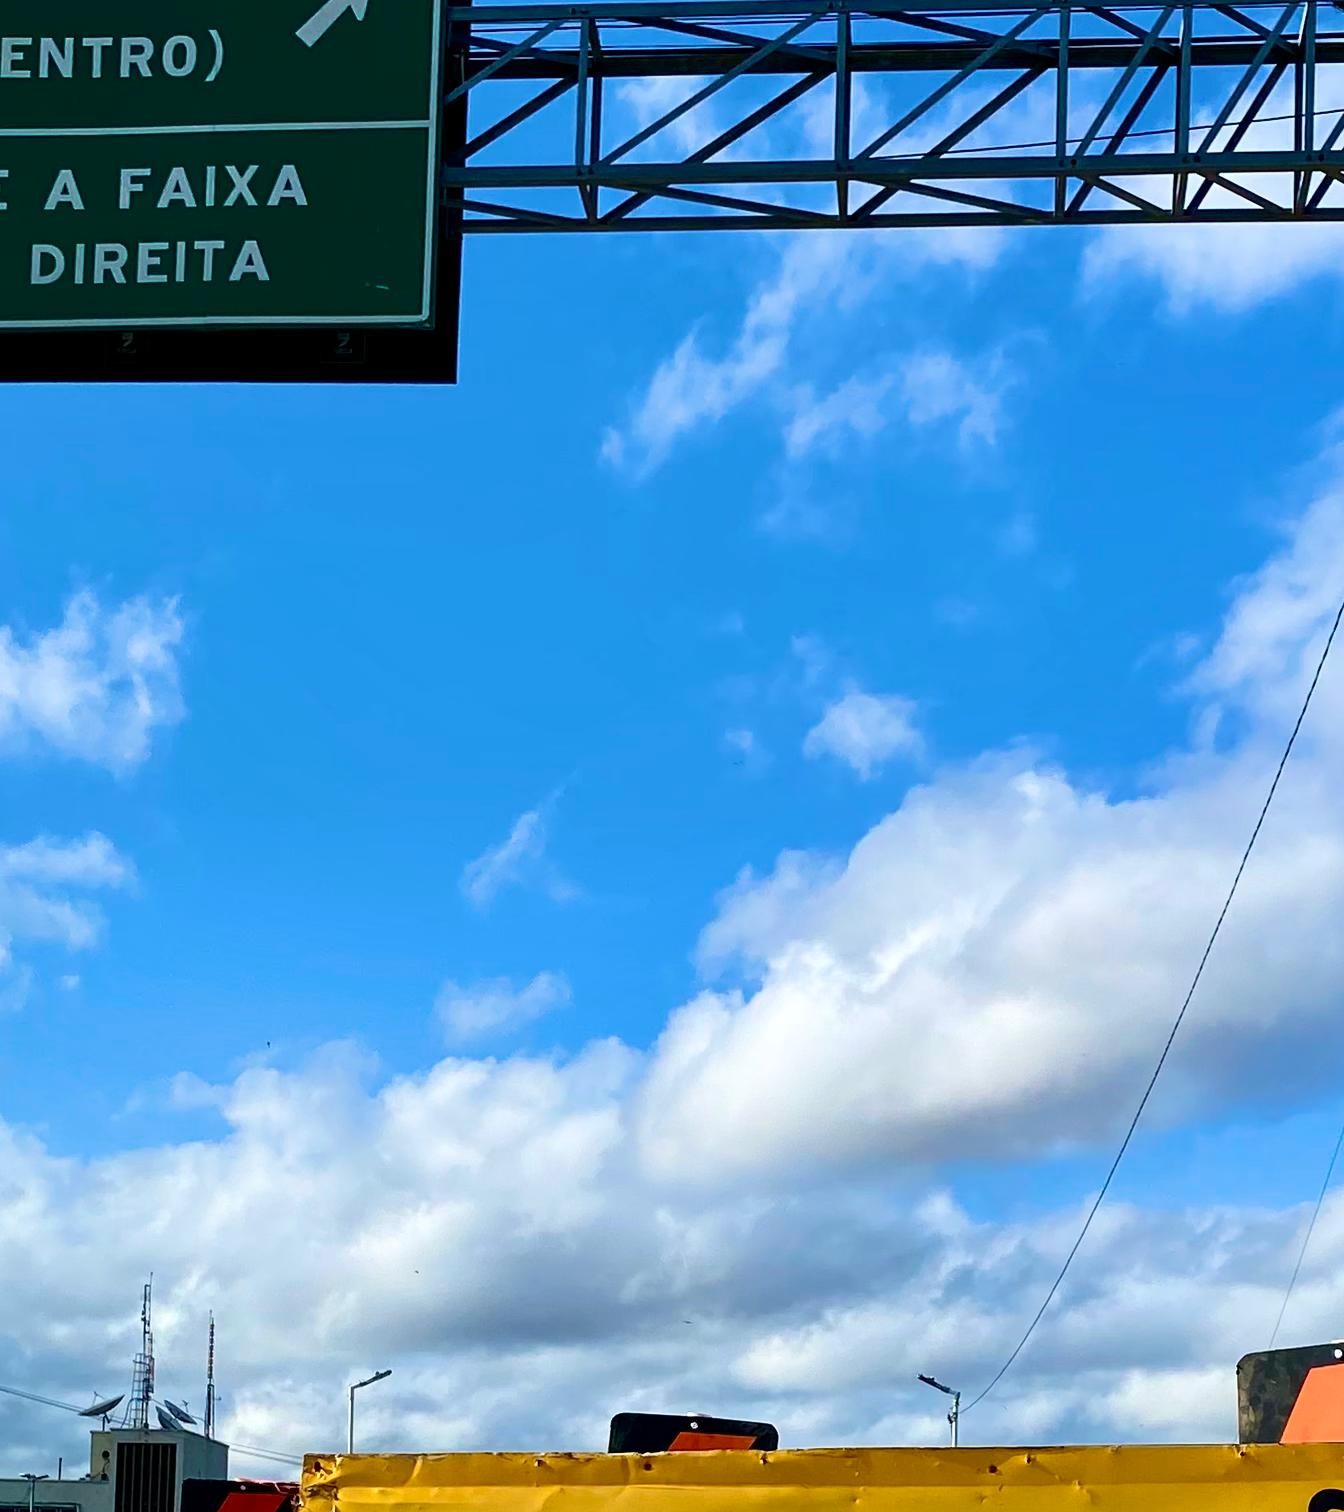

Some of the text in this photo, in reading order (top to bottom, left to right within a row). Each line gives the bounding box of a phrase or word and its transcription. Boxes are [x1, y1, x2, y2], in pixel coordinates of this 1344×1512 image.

[45, 169, 85, 210] A
[118, 164, 308, 209] FAIXA
[30, 240, 270, 285] DIREITA
